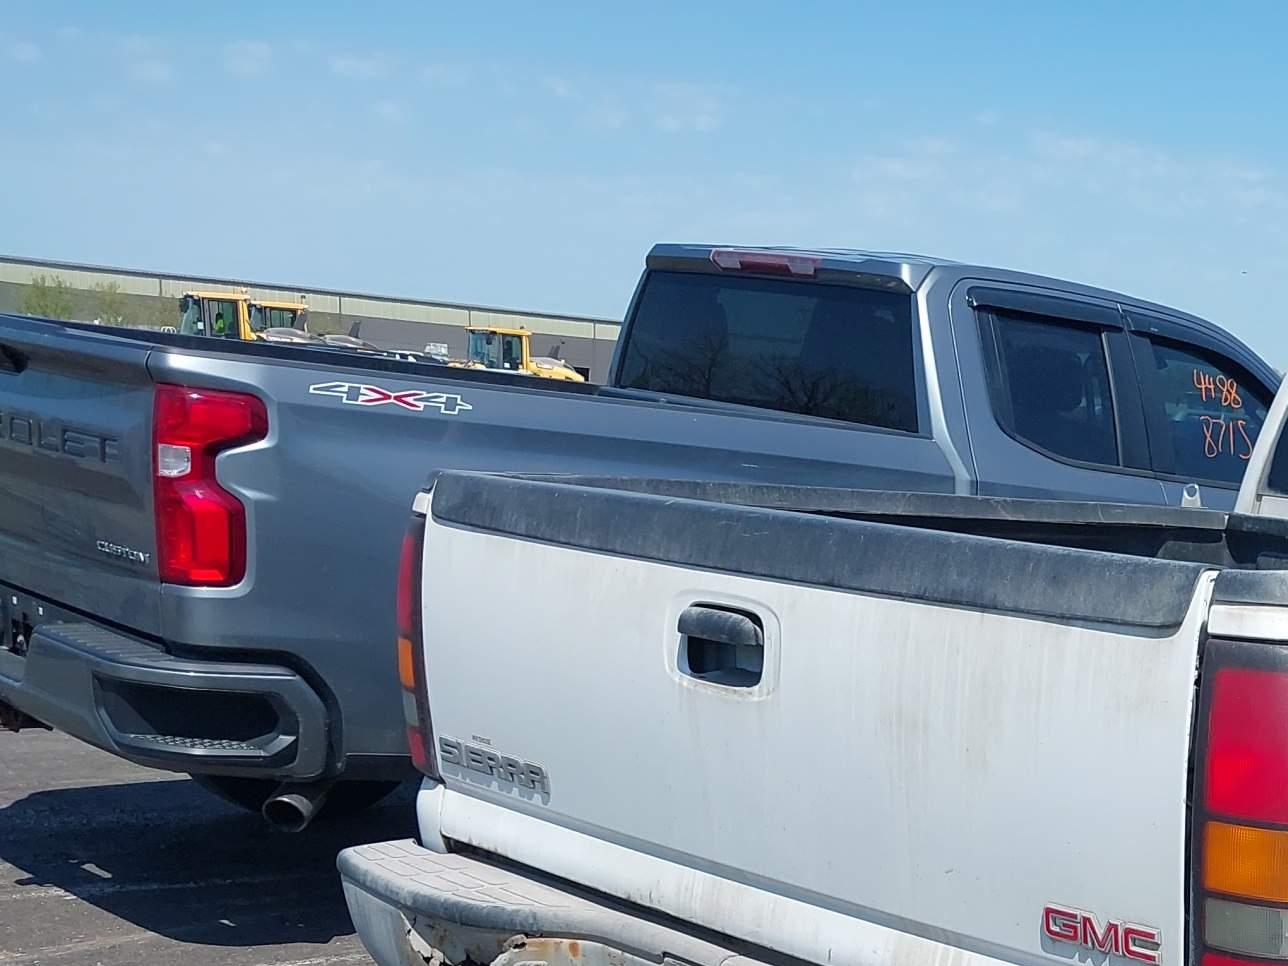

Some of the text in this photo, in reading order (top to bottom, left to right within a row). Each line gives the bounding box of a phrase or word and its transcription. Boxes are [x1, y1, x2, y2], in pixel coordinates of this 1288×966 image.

[1193, 368, 1242, 408] 4488
[0, 409, 121, 464] OLET
[96, 540, 150, 563] CUSTOM
[438, 735, 551, 795] SIERRA
[1041, 901, 1163, 966] GMC
